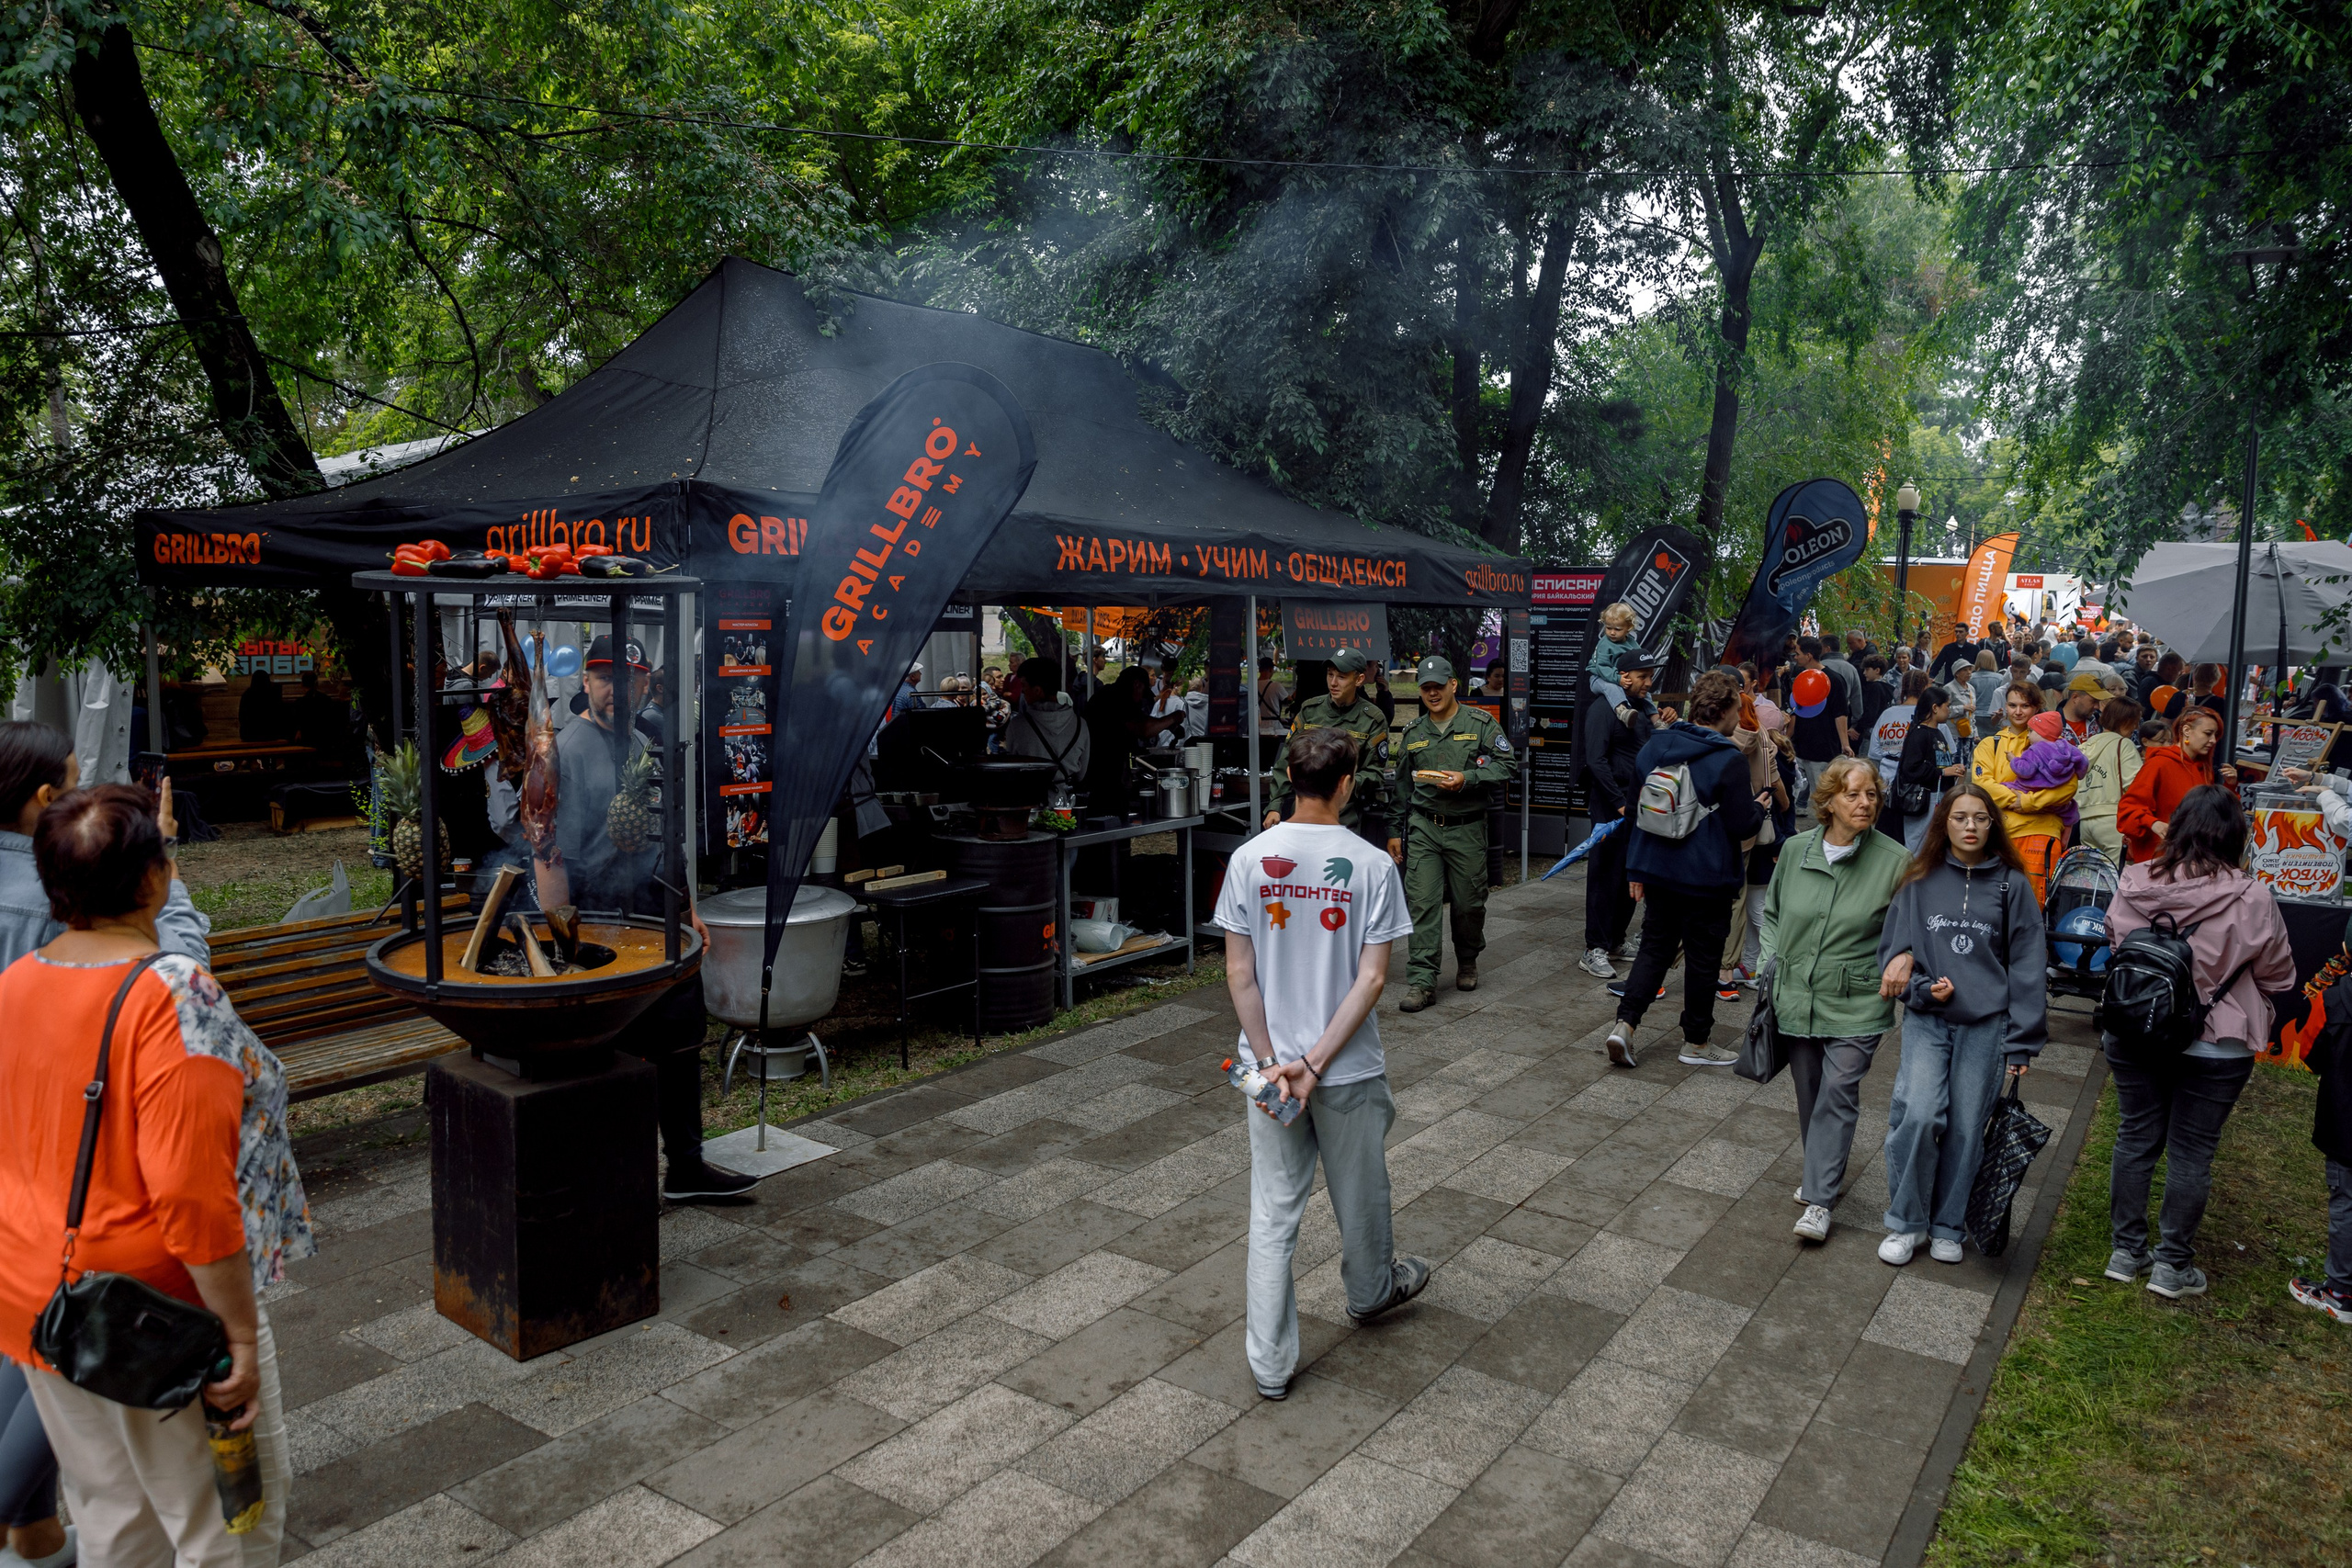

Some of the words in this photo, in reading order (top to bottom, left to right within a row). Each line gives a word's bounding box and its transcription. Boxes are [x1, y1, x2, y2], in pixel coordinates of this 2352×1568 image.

[728, 513, 808, 556] GRI
[820, 425, 958, 641] GRILLBRO
[153, 532, 263, 565] GRILLBRO
[856, 441, 982, 656] ACADEMY
[1055, 535, 1172, 575] ЖАРИМ
[1195, 545, 1269, 580] УЧИМ
[1288, 552, 1407, 589] ОБЩАЕМСЯ
[1464, 564, 1524, 595] grillbro.ru
[1532, 580, 1601, 591] СПИСАН
[1974, 550, 1997, 604] ПИЦЦА
[1294, 606, 1370, 632] GRILLBRO
[1297, 636, 1373, 649] ACADEMY
[1883, 728, 1905, 740] 100
[2276, 868, 2331, 881] КУБОК
[1260, 884, 1352, 904] ВОЛОНТЕР
[1927, 914, 1959, 932] Aspire
[1961, 919, 1971, 929] to
